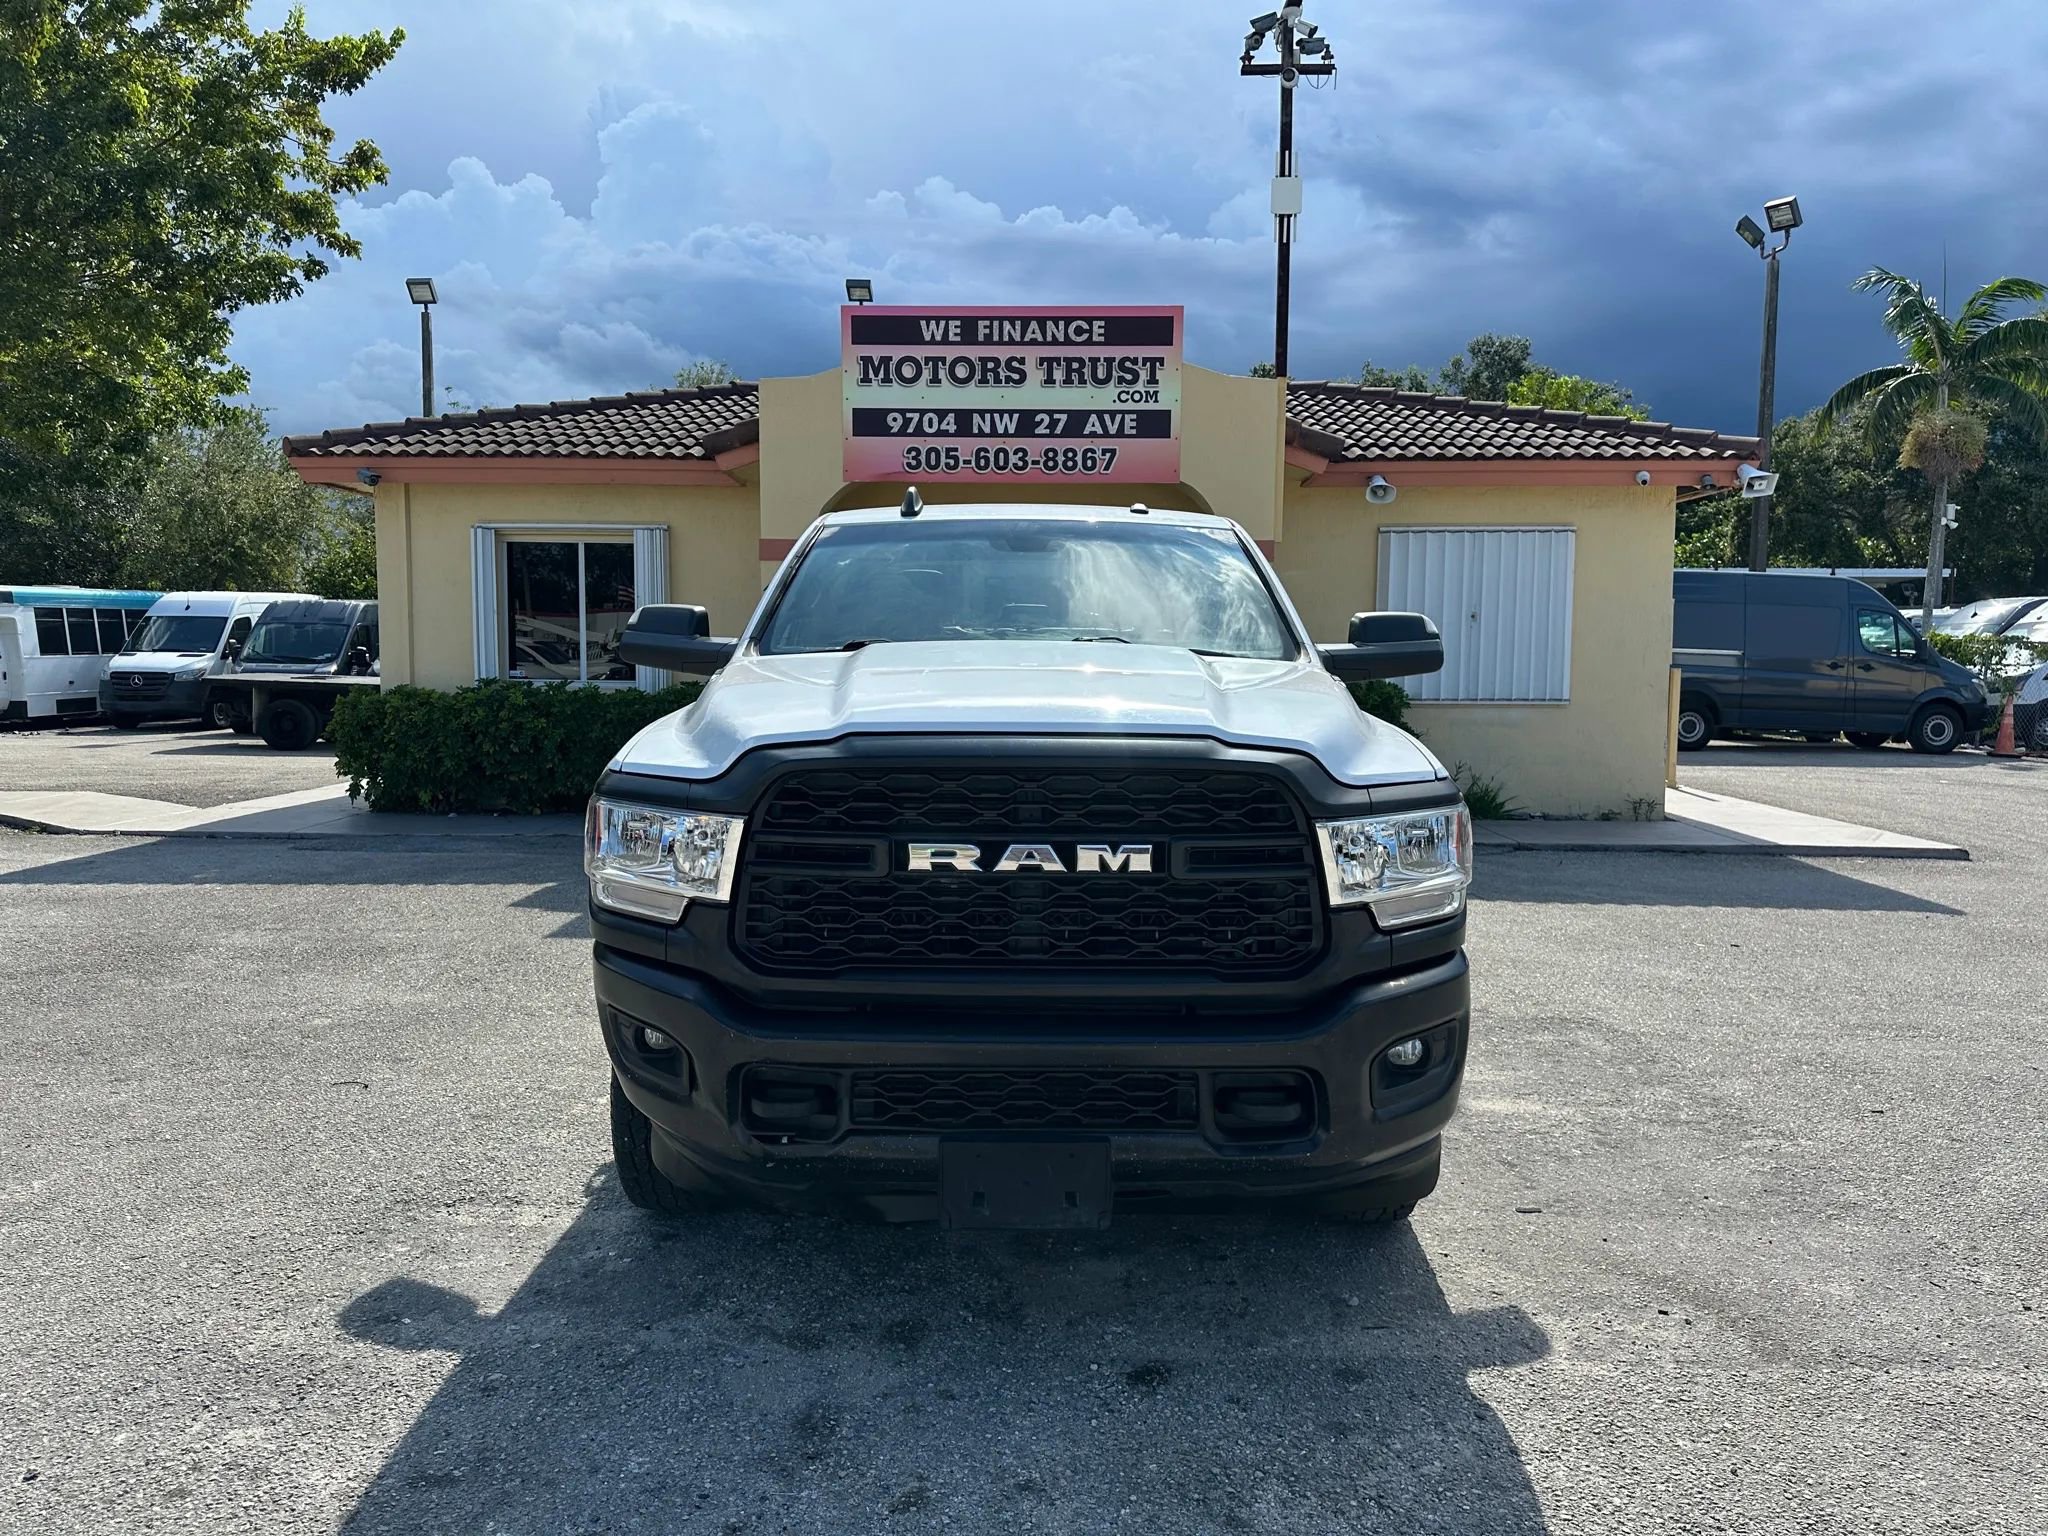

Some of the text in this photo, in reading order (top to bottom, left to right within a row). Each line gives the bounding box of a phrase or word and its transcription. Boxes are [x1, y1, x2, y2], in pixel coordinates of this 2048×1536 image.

[920, 320, 1105, 342] WE FINANCE
[857, 355, 1165, 386] MOTORS TRUST
[1112, 390, 1160, 404] .COM
[886, 413, 1137, 434] 9704 NW 27 AVE
[903, 446, 1119, 474] 305-603-8867
[908, 843, 1152, 872] RAM
